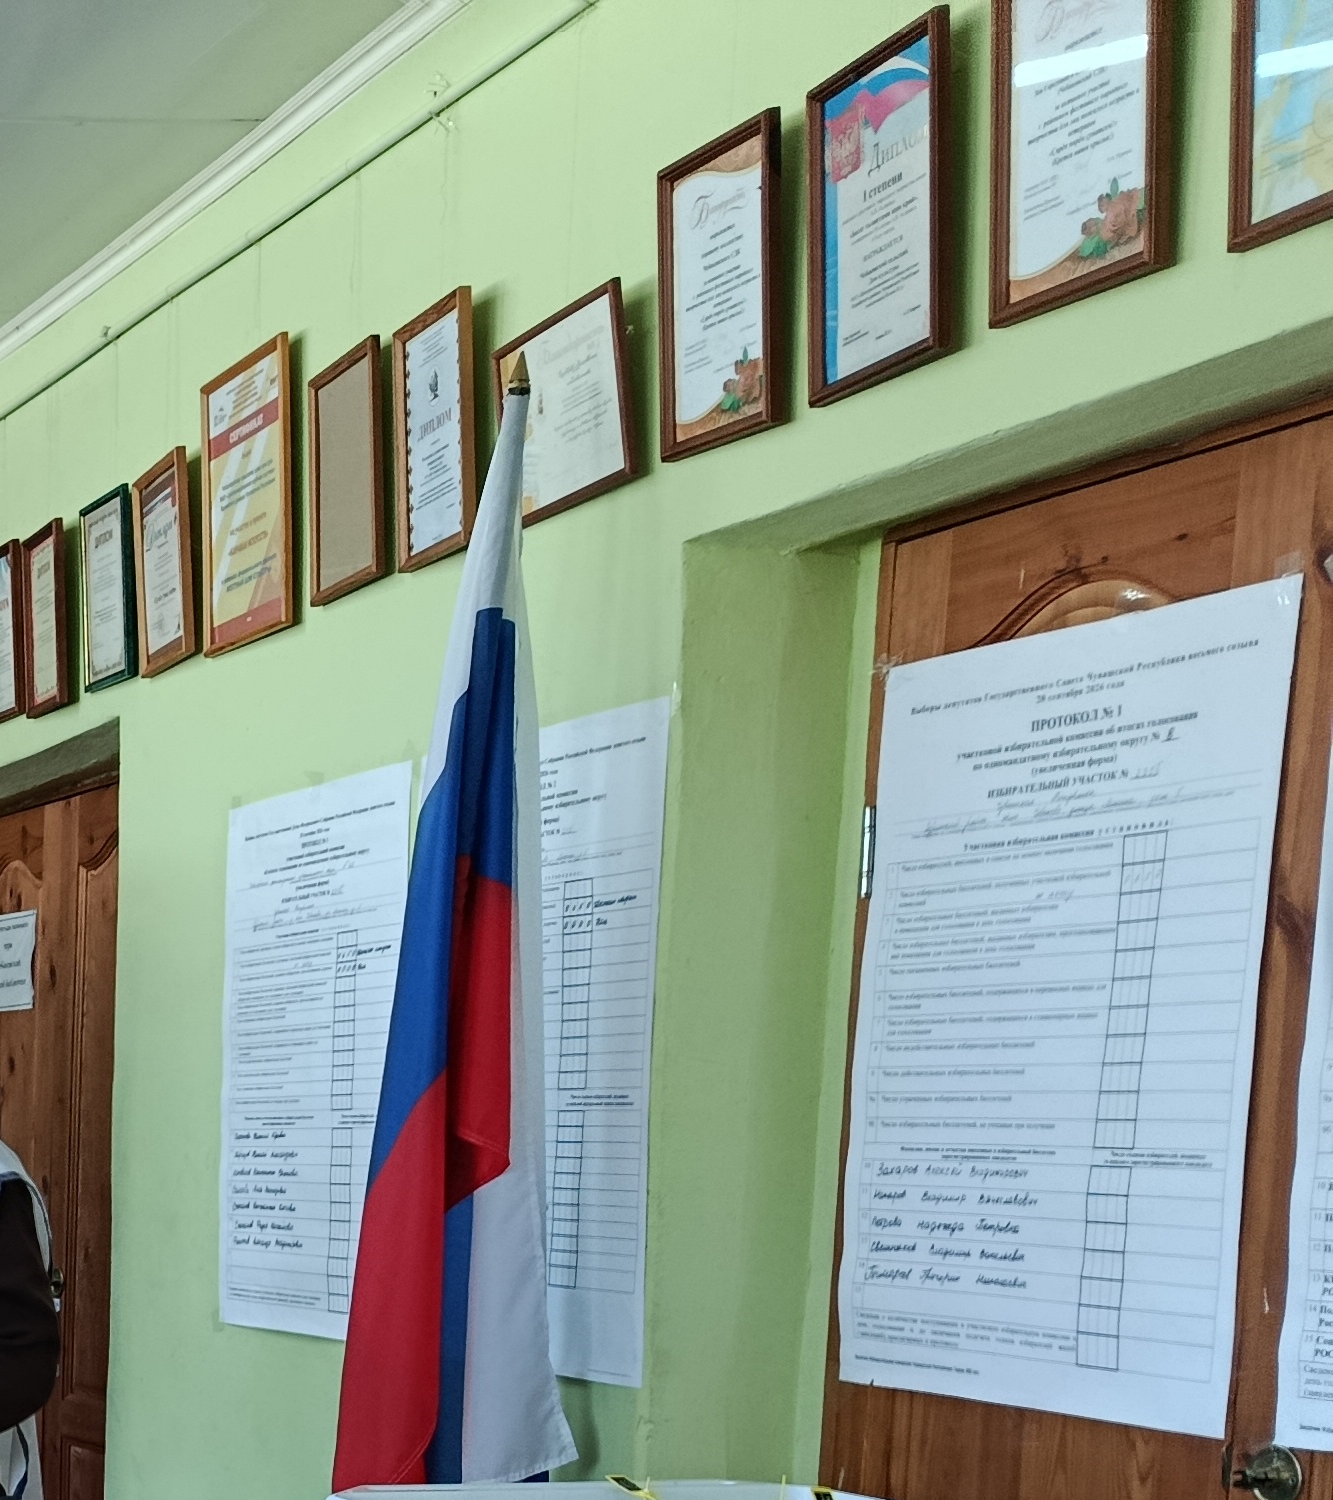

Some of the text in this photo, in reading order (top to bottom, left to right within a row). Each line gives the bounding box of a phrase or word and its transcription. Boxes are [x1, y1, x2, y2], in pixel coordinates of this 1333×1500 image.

[868, 171, 903, 199] степени
[1031, 708, 1099, 733] ПРОТОКОЛ
[1072, 769, 1118, 785] УЧАСТОК
